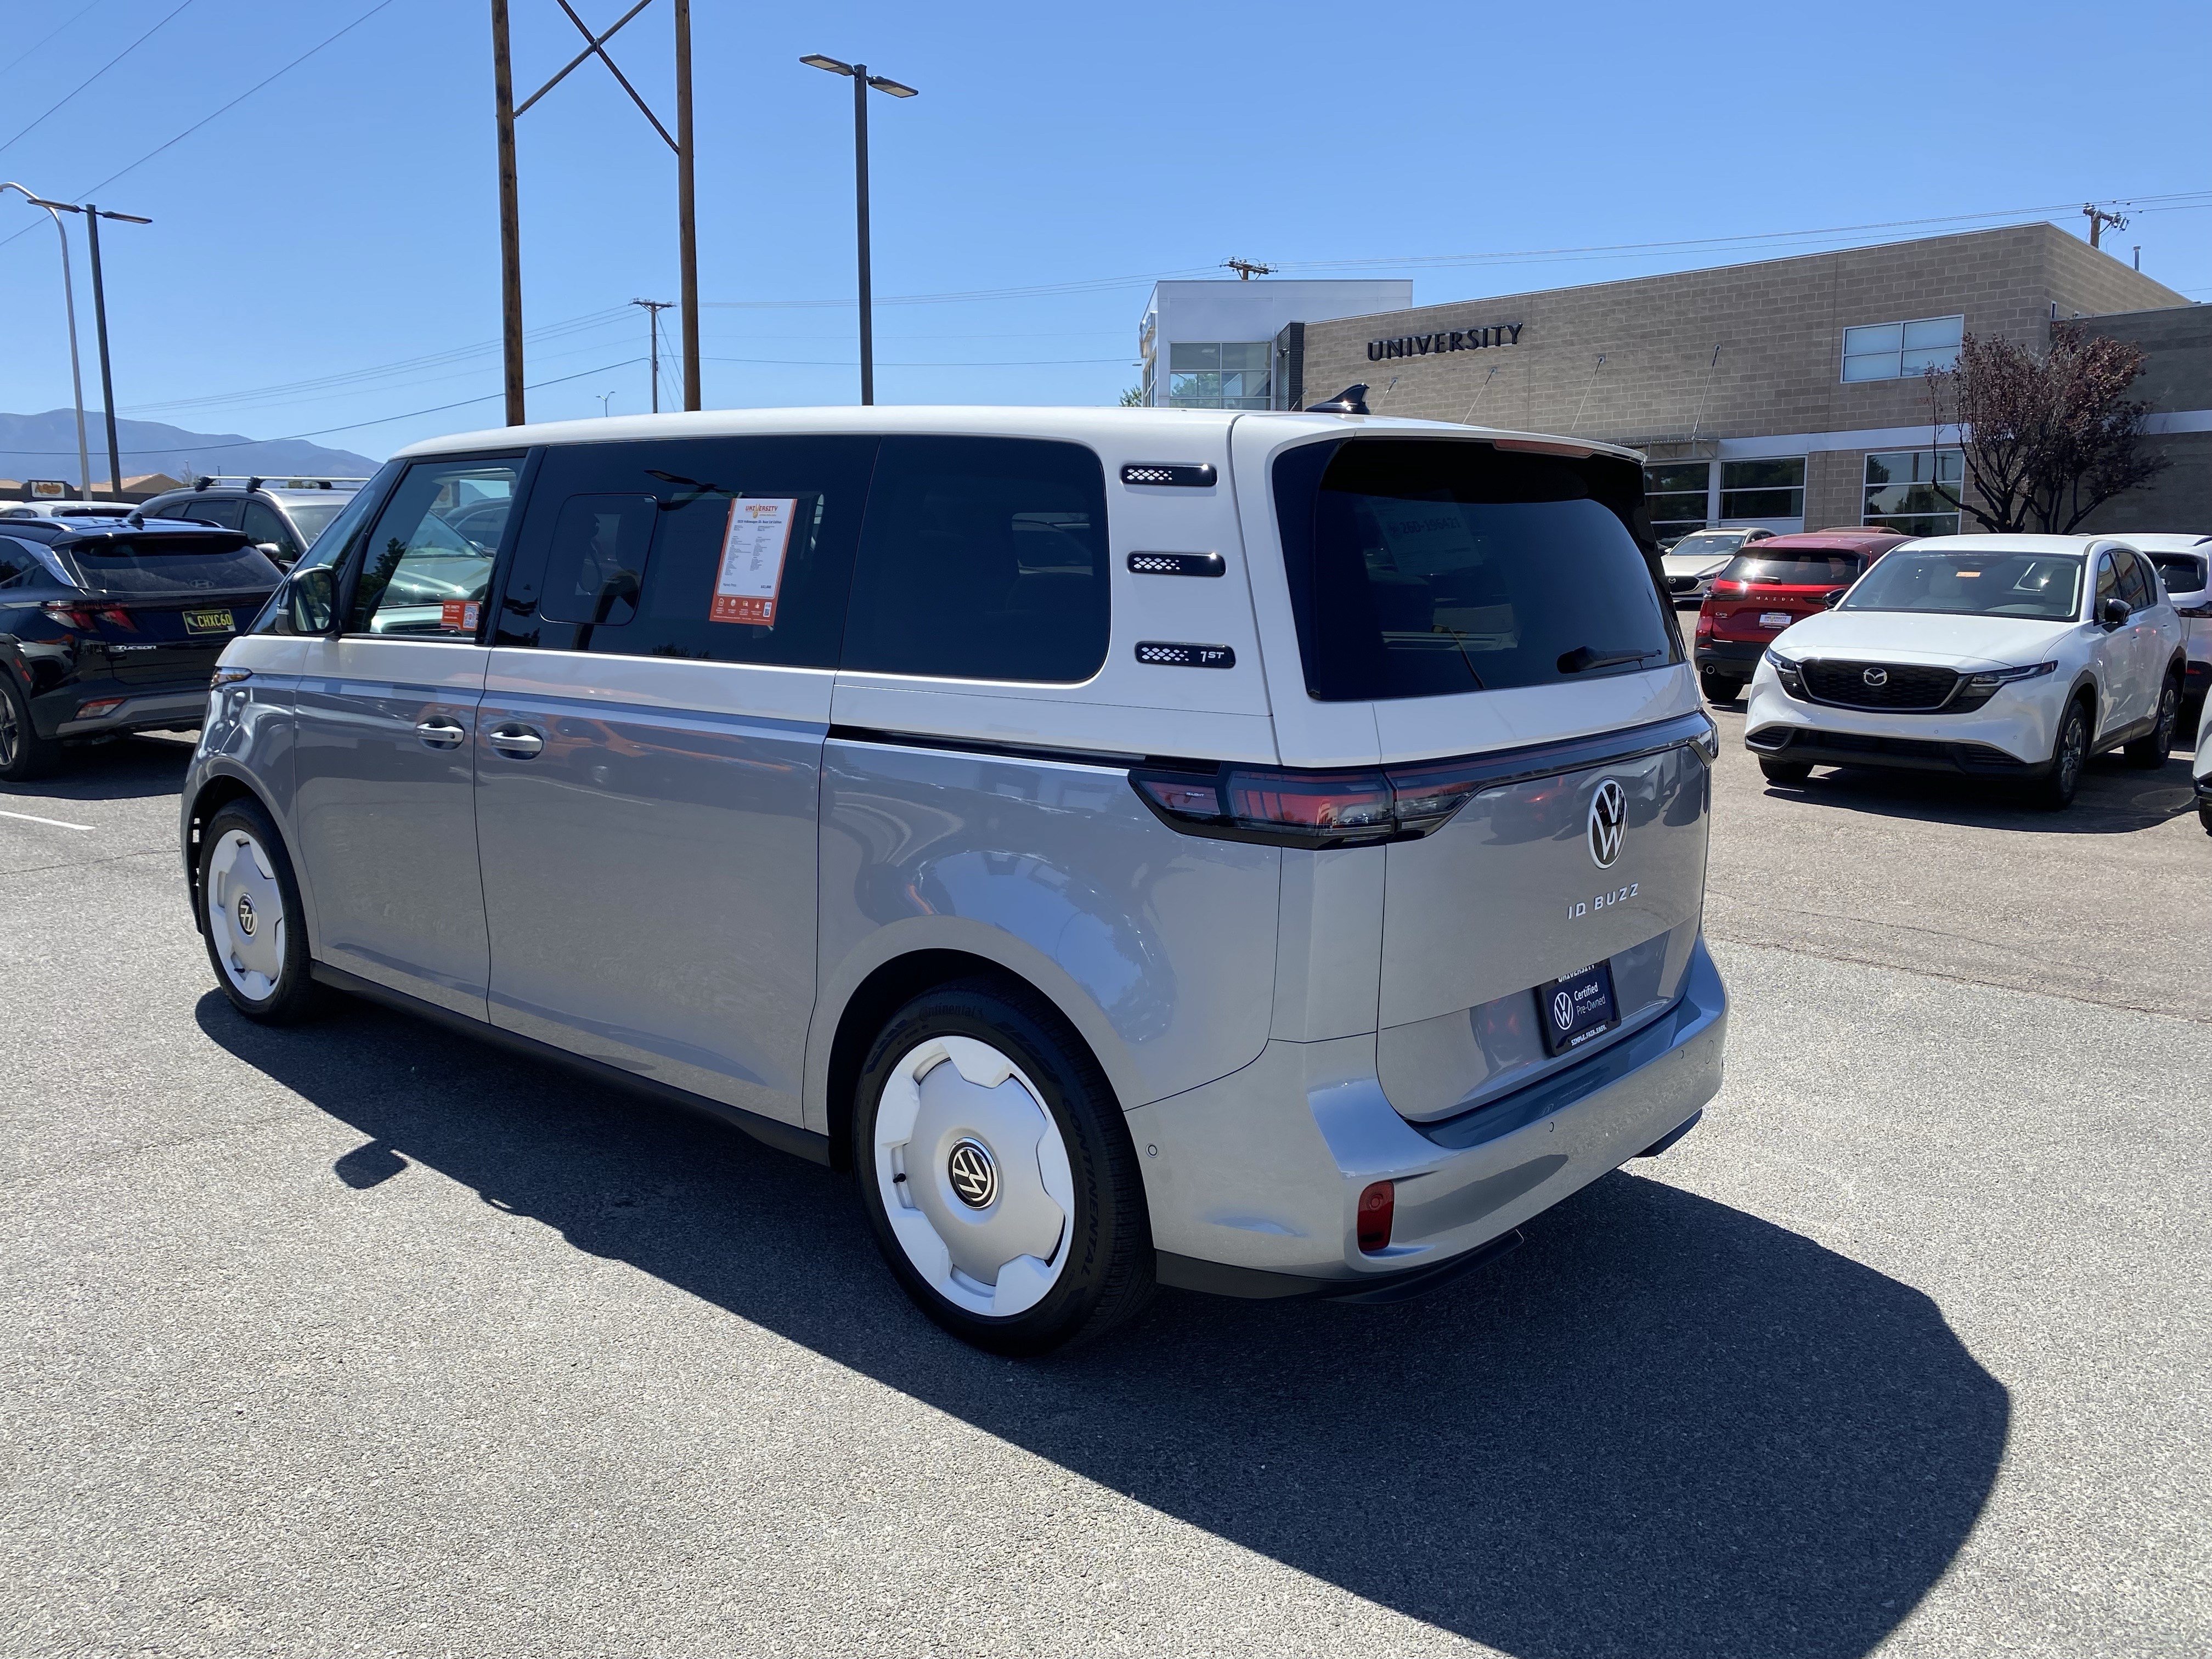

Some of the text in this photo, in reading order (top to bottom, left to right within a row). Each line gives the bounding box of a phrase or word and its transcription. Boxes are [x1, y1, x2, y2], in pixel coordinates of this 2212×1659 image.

[1368, 322, 1523, 362] UNIVERSITY
[197, 613, 232, 628] CHXC60
[1200, 651, 1224, 662] 1ST
[1594, 882, 1639, 911] BUZZ
[1574, 981, 1599, 1002] Certified
[1576, 994, 1606, 1016] Pre-Owned
